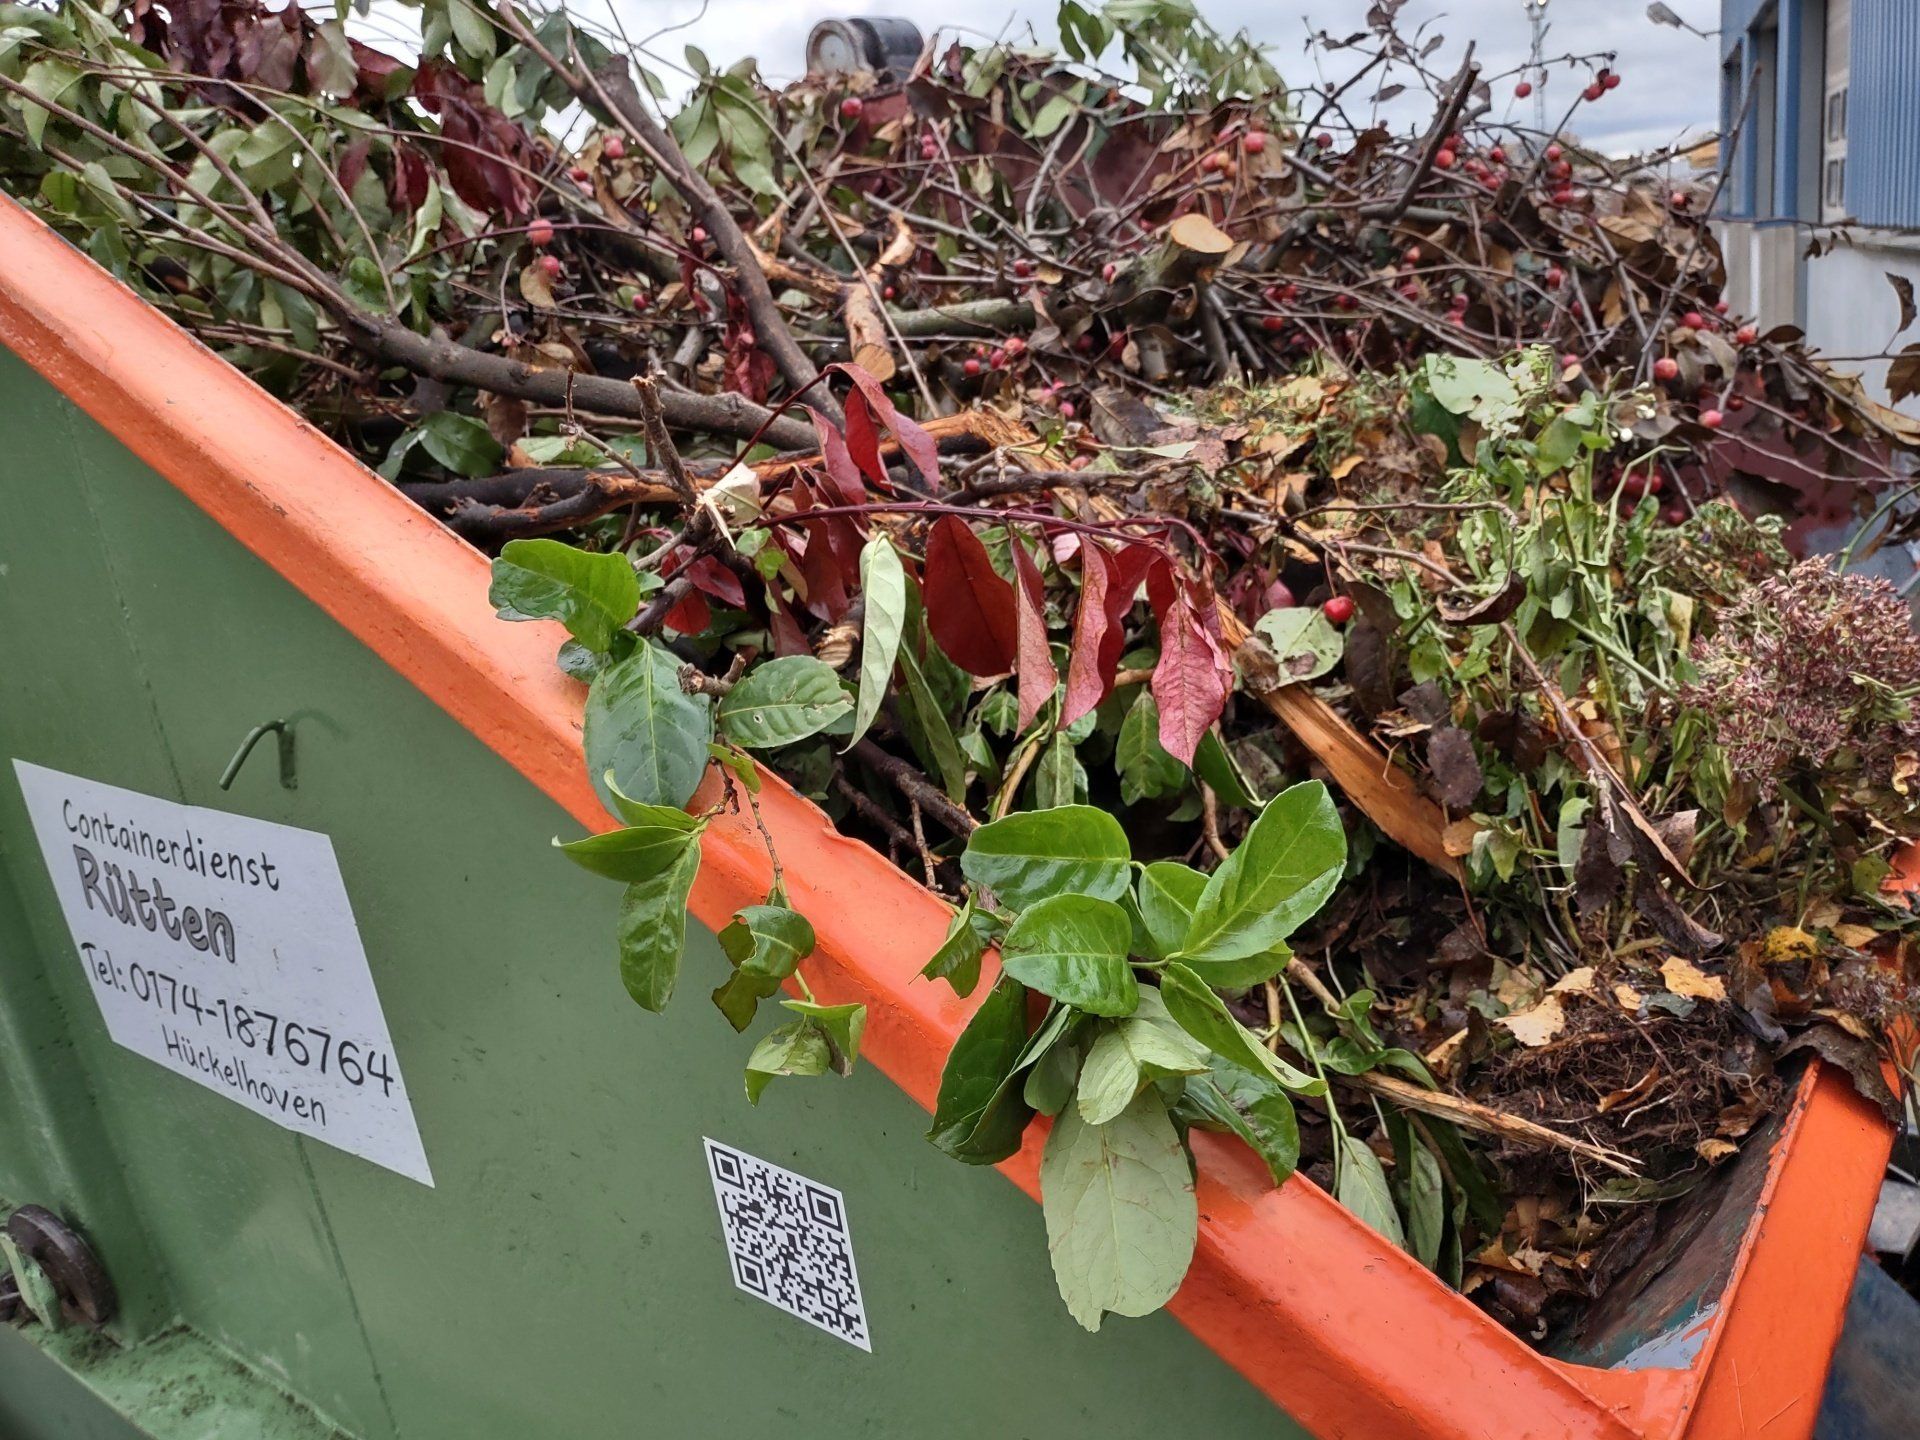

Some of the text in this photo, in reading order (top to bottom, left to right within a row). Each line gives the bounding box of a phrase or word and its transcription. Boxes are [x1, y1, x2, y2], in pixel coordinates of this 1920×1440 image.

[62, 799, 279, 890] Containerdienst
[73, 844, 236, 963] Rütten
[130, 963, 395, 1097] 0174-1876764
[162, 1024, 326, 1126] Hückelhoven
